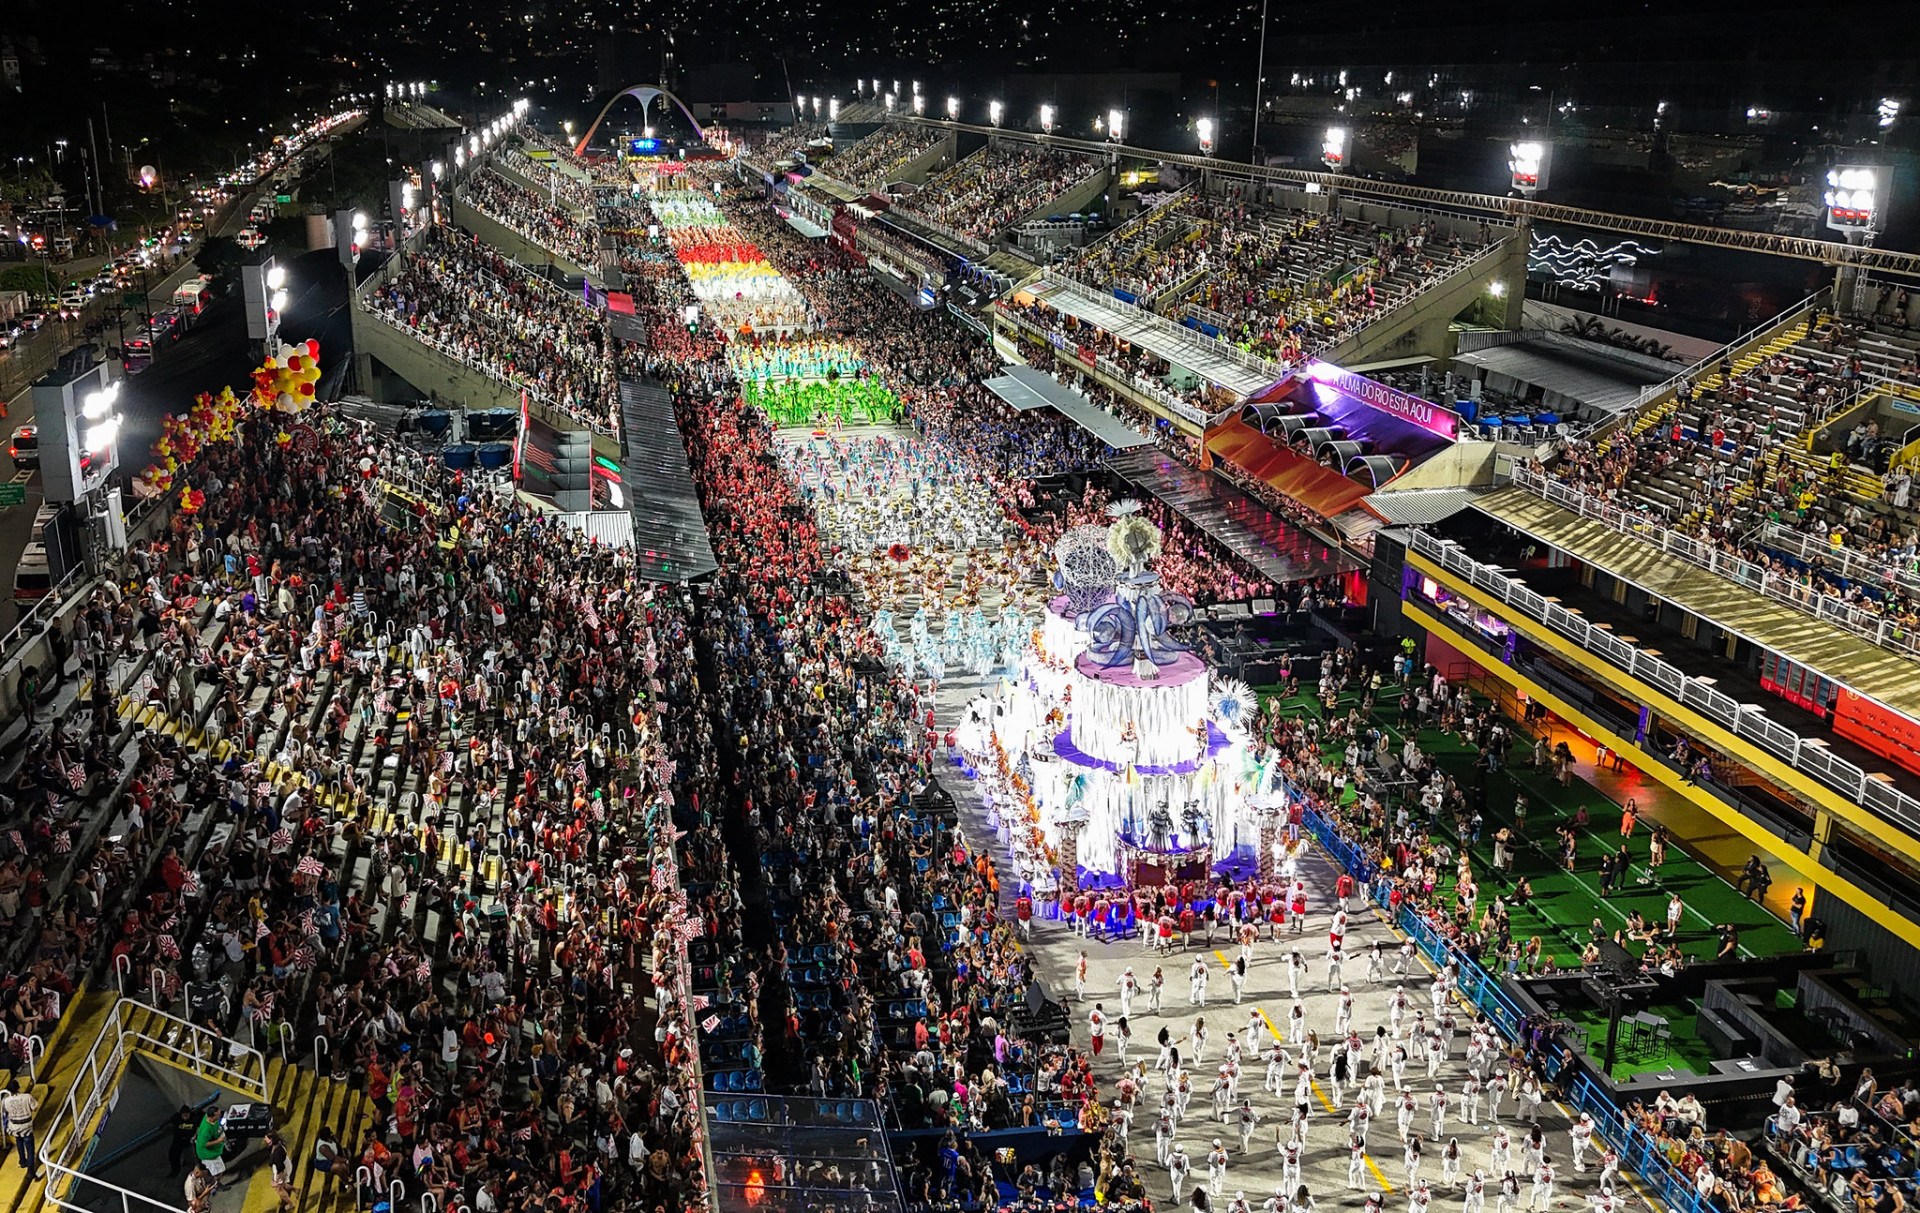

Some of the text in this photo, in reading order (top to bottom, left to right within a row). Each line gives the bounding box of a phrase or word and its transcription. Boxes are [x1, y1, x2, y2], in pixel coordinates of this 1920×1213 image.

[1340, 374, 1360, 394] ALMA
[1361, 383, 1374, 399] DO
[1375, 387, 1389, 405] RIO
[1389, 393, 1409, 415] ESTÁ
[1410, 402, 1432, 424] AQUI
